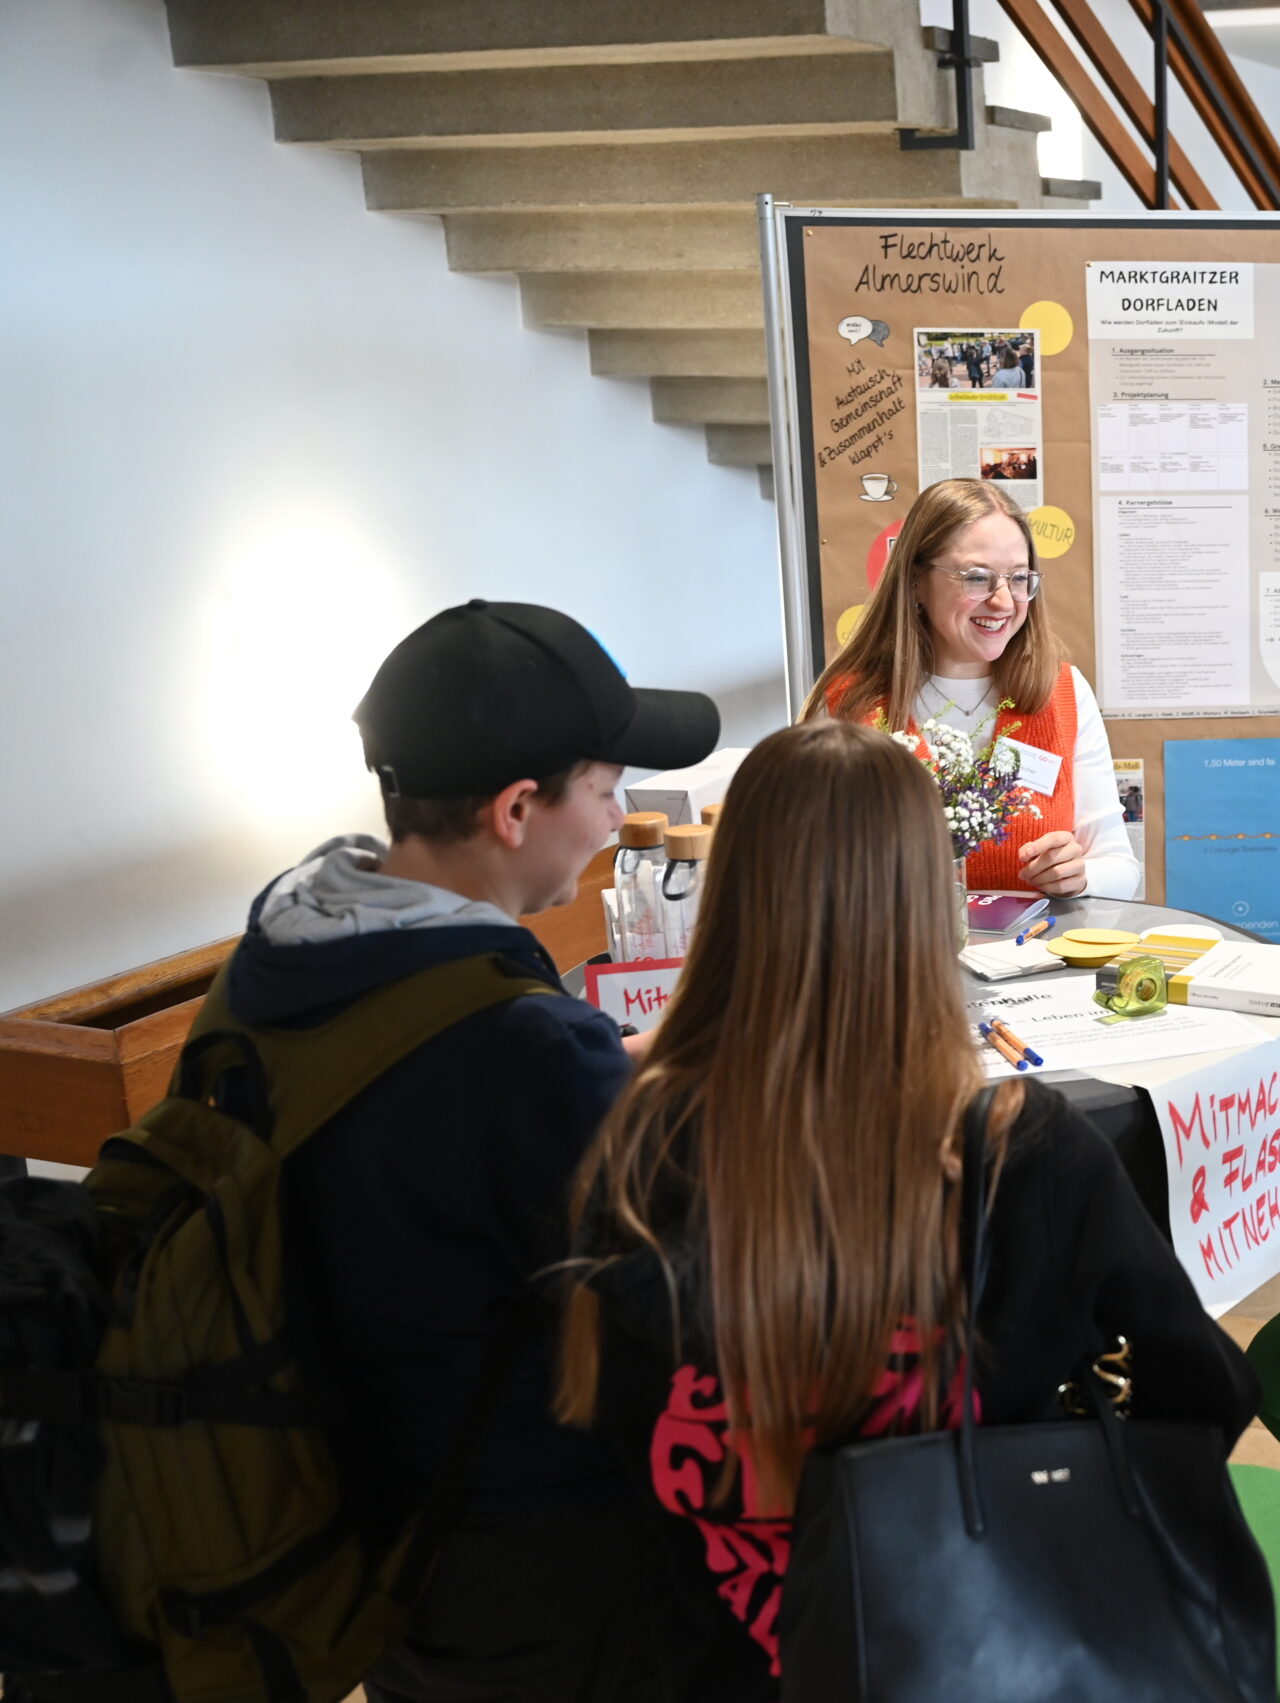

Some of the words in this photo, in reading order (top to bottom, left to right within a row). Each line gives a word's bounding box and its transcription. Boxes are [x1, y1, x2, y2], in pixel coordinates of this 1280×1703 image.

[880, 232, 1005, 262] Flechtwerk
[855, 264, 1005, 294] Almerswind
[1099, 270, 1239, 285] MARKTGRAITZER
[1121, 297, 1218, 312] DORFLADEN
[846, 358, 866, 377] Mit
[830, 371, 904, 433] Gemeinschaft
[817, 451, 827, 468] &
[823, 397, 906, 461] Zusammenhalt
[1223, 759, 1246, 767] Meter
[1247, 758, 1264, 766] sind
[624, 986, 668, 1017] Mit
[1190, 1165, 1210, 1225] &
